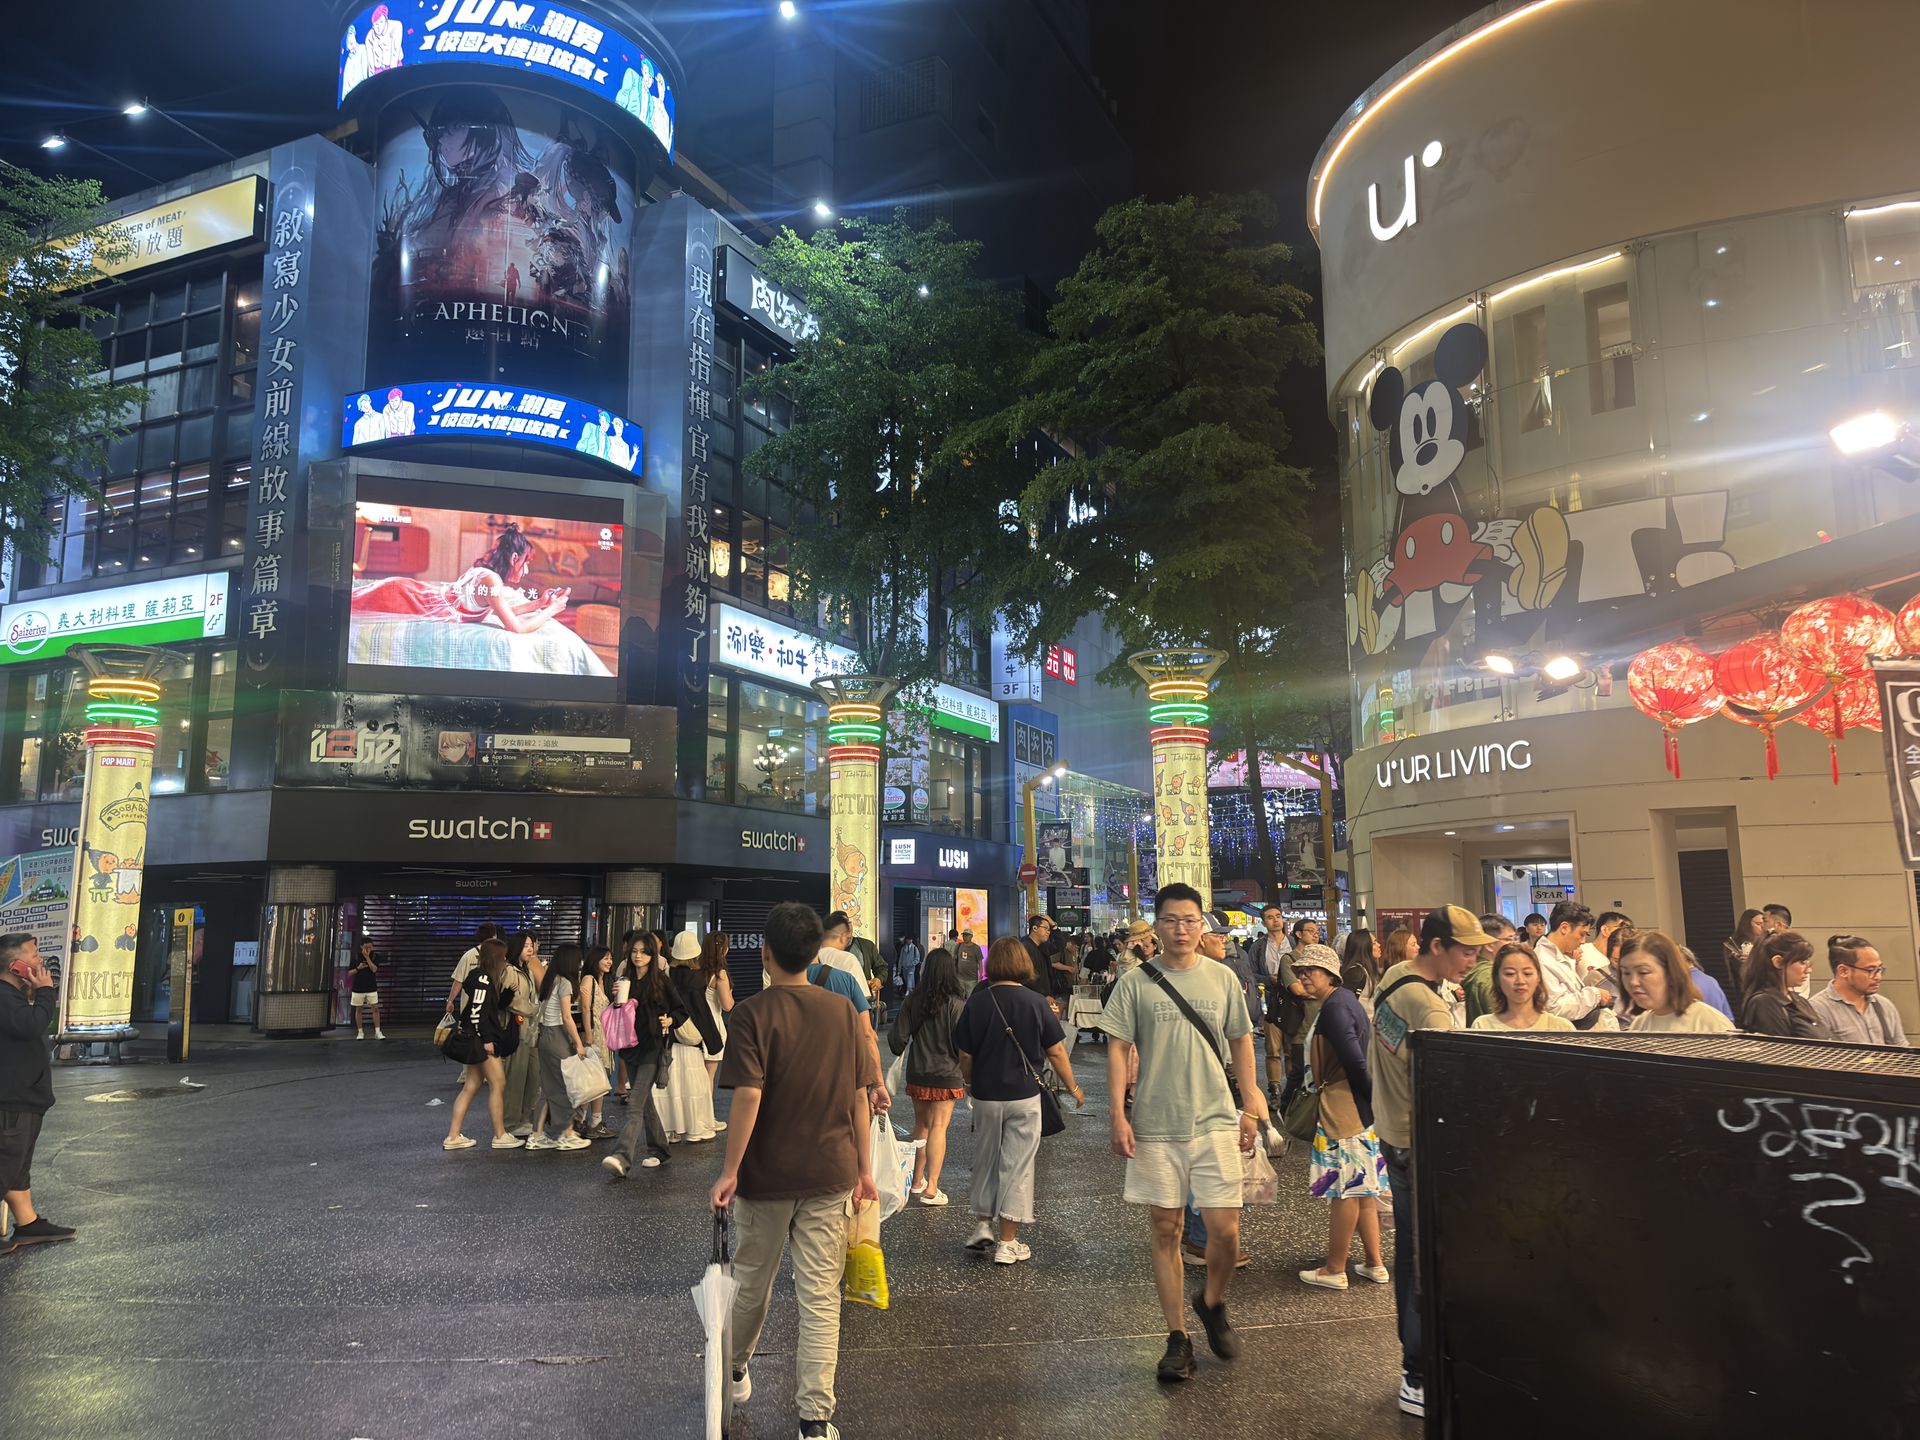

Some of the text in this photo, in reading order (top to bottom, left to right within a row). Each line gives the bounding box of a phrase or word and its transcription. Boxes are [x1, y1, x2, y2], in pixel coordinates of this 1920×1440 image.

[425, 0, 535, 32] JUN
[539, 10, 604, 55] 潮男
[145, 218, 156, 230] of
[157, 210, 182, 227] MEAT
[434, 301, 568, 340] APHELION
[432, 388, 514, 413] JUN
[517, 393, 567, 419] 潮男
[685, 264, 713, 663] 現在指揮官有我就夠了
[209, 593, 224, 607] 2F
[58, 594, 194, 630] 義大利料理 薩莉亞
[10, 624, 47, 644] Saizeriya
[1063, 651, 1074, 668] UNI
[1063, 664, 1075, 681] QLO
[1003, 683, 1019, 695] 3F
[101, 757, 115, 765] POP
[115, 758, 136, 767] MART
[492, 754, 502, 762] App
[545, 755, 561, 763] Google
[1310, 754, 1319, 763] 4F
[1436, 740, 1532, 779] LIVING
[408, 816, 530, 840] swatch
[742, 830, 796, 851] swatch
[939, 847, 969, 869] LUSH
[455, 879, 492, 888] swatch
[1534, 890, 1563, 899] STAR
